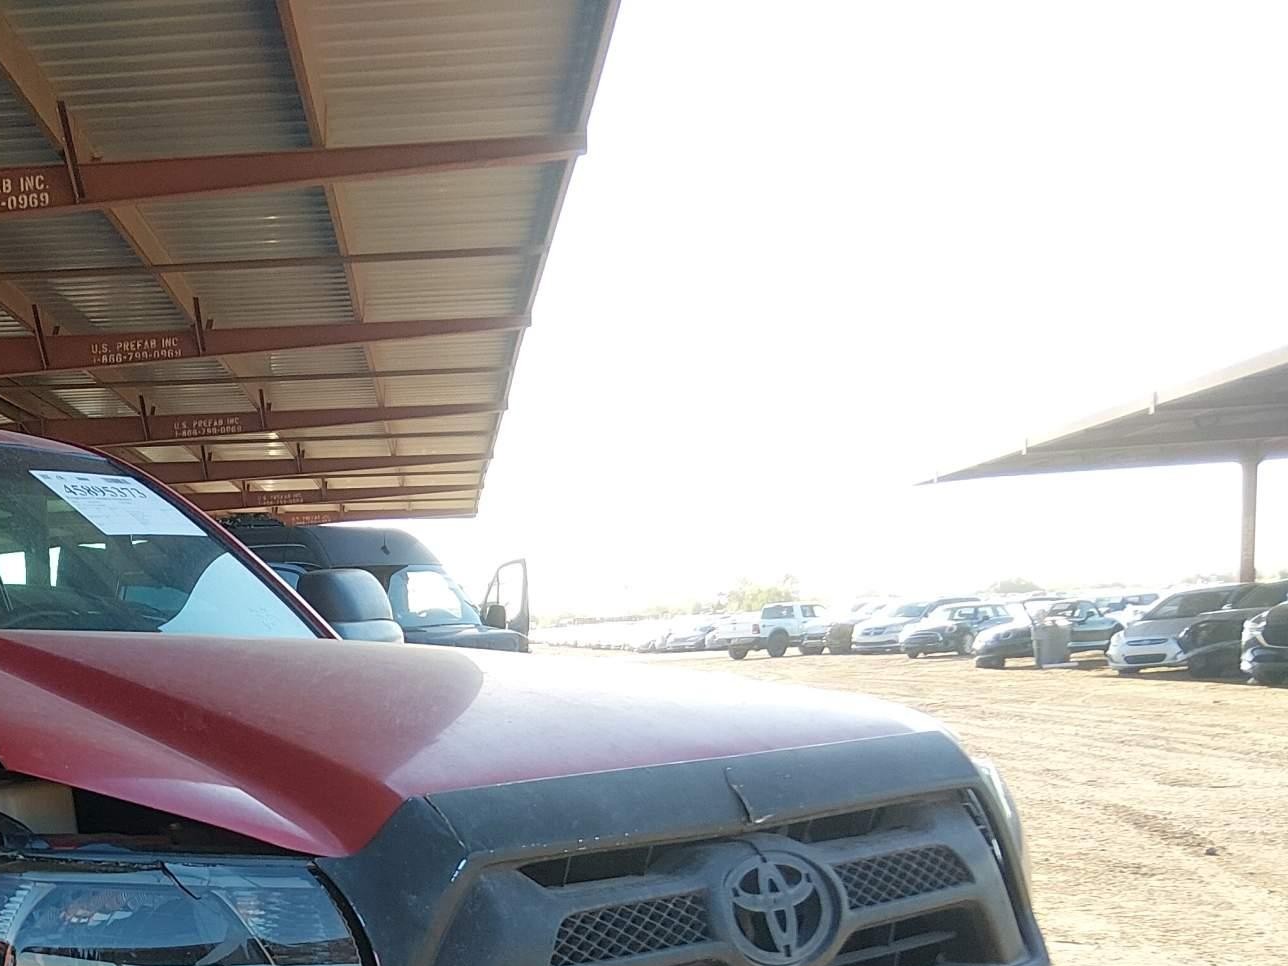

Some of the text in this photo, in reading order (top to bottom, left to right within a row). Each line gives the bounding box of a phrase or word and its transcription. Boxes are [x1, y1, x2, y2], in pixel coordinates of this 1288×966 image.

[20, 174, 49, 192] INC.
[91, 343, 111, 354] U.S.
[116, 338, 157, 352] PREFAB
[63, 483, 149, 500] 45895373
